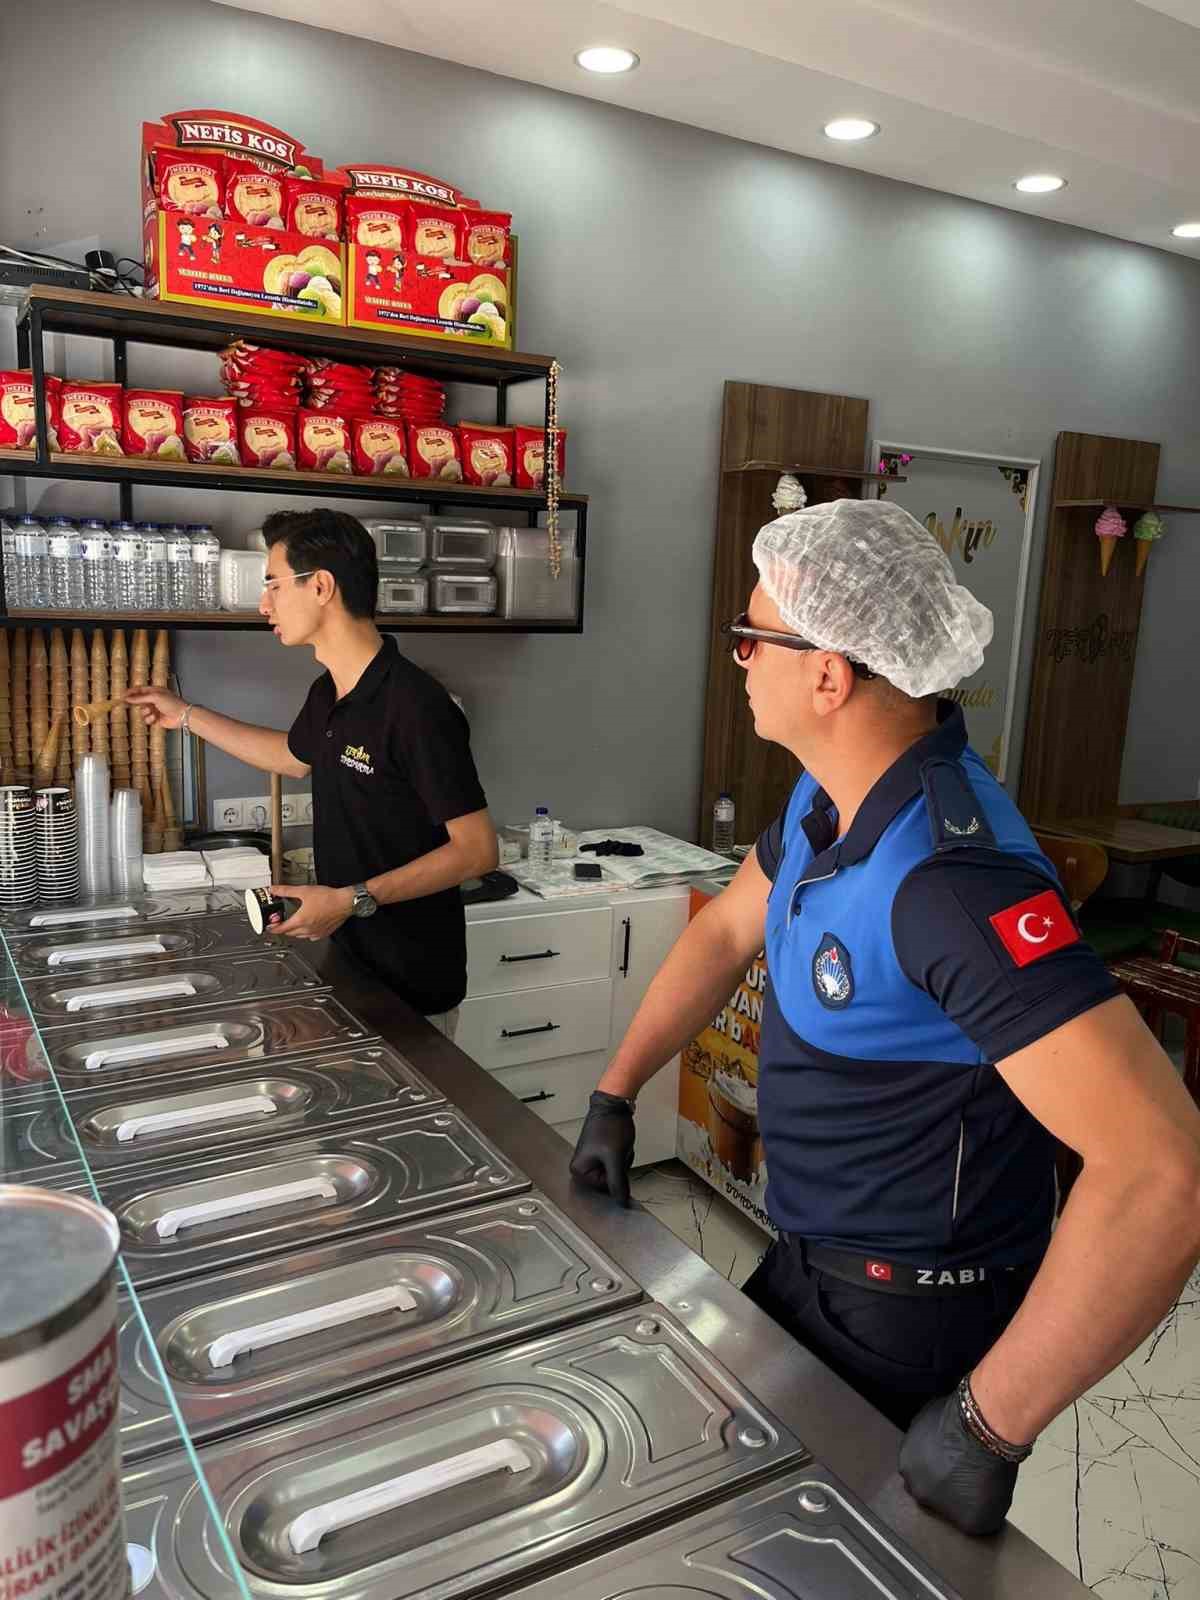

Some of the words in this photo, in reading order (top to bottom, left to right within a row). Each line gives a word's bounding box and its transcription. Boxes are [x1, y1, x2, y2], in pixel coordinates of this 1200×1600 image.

[183, 123, 243, 145] NEFİS
[247, 134, 288, 157] KOS
[357, 173, 408, 189] NEFİS
[412, 180, 449, 199] KOS
[916, 1267, 987, 1286] ZABI
